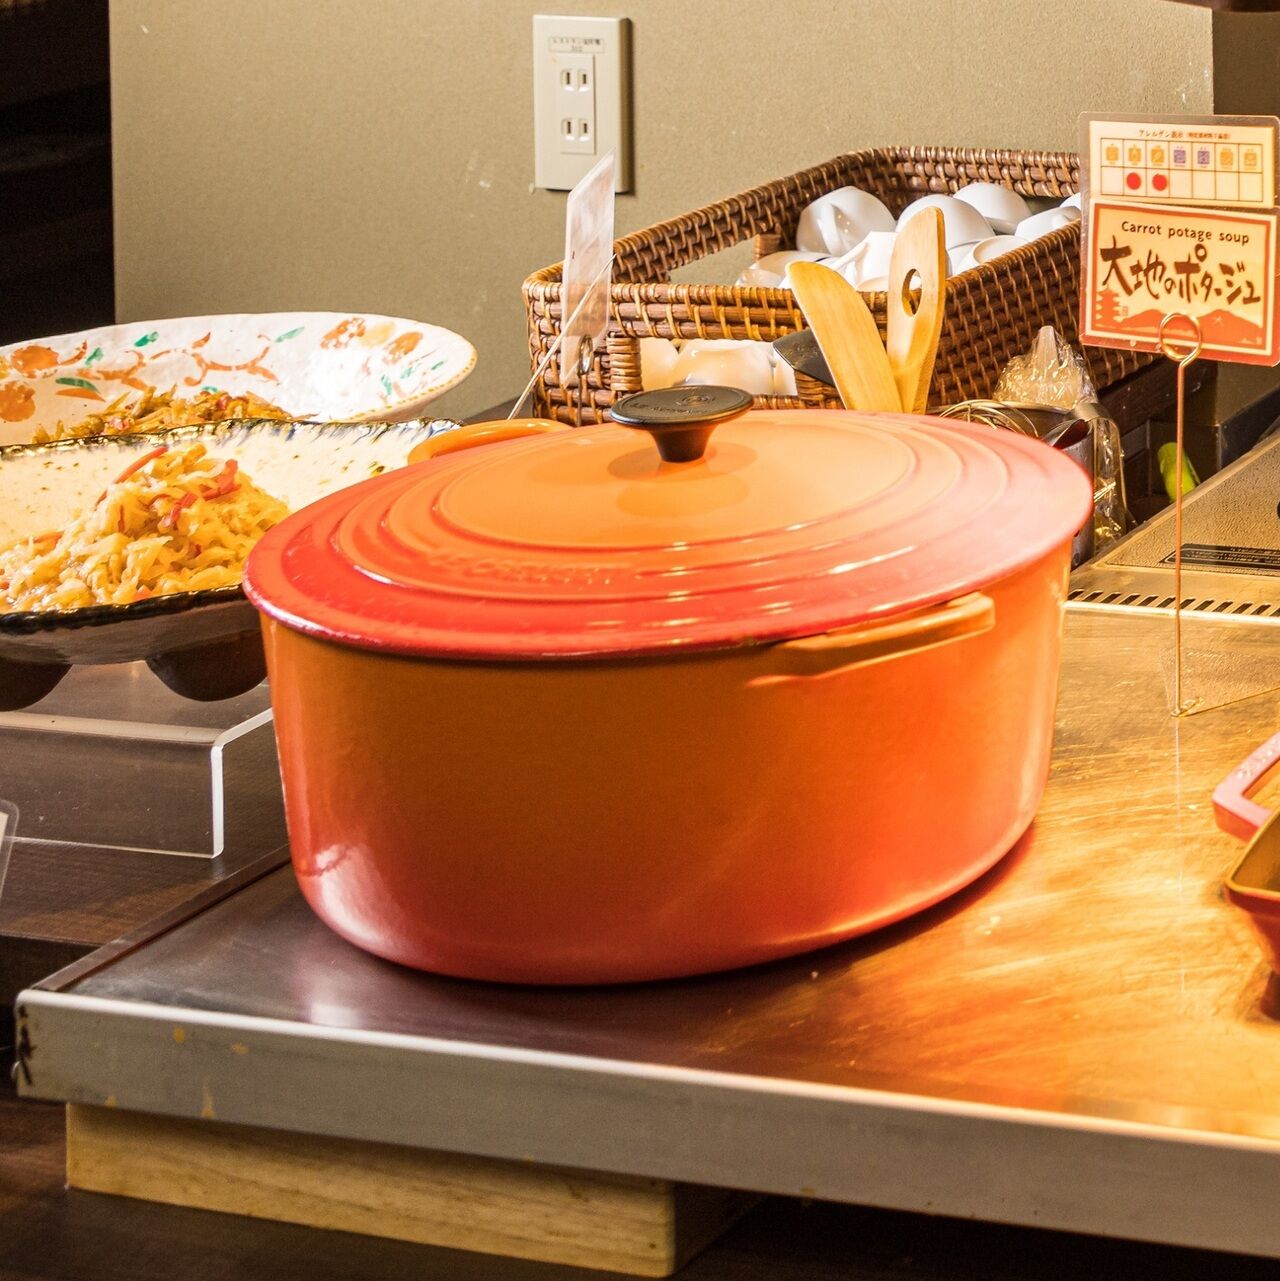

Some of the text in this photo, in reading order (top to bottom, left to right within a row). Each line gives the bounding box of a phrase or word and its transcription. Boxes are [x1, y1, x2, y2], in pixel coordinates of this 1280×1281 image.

[1121, 220, 1250, 246] Carrot potage soup
[1100, 235, 1261, 305] 大地のポタージュ
